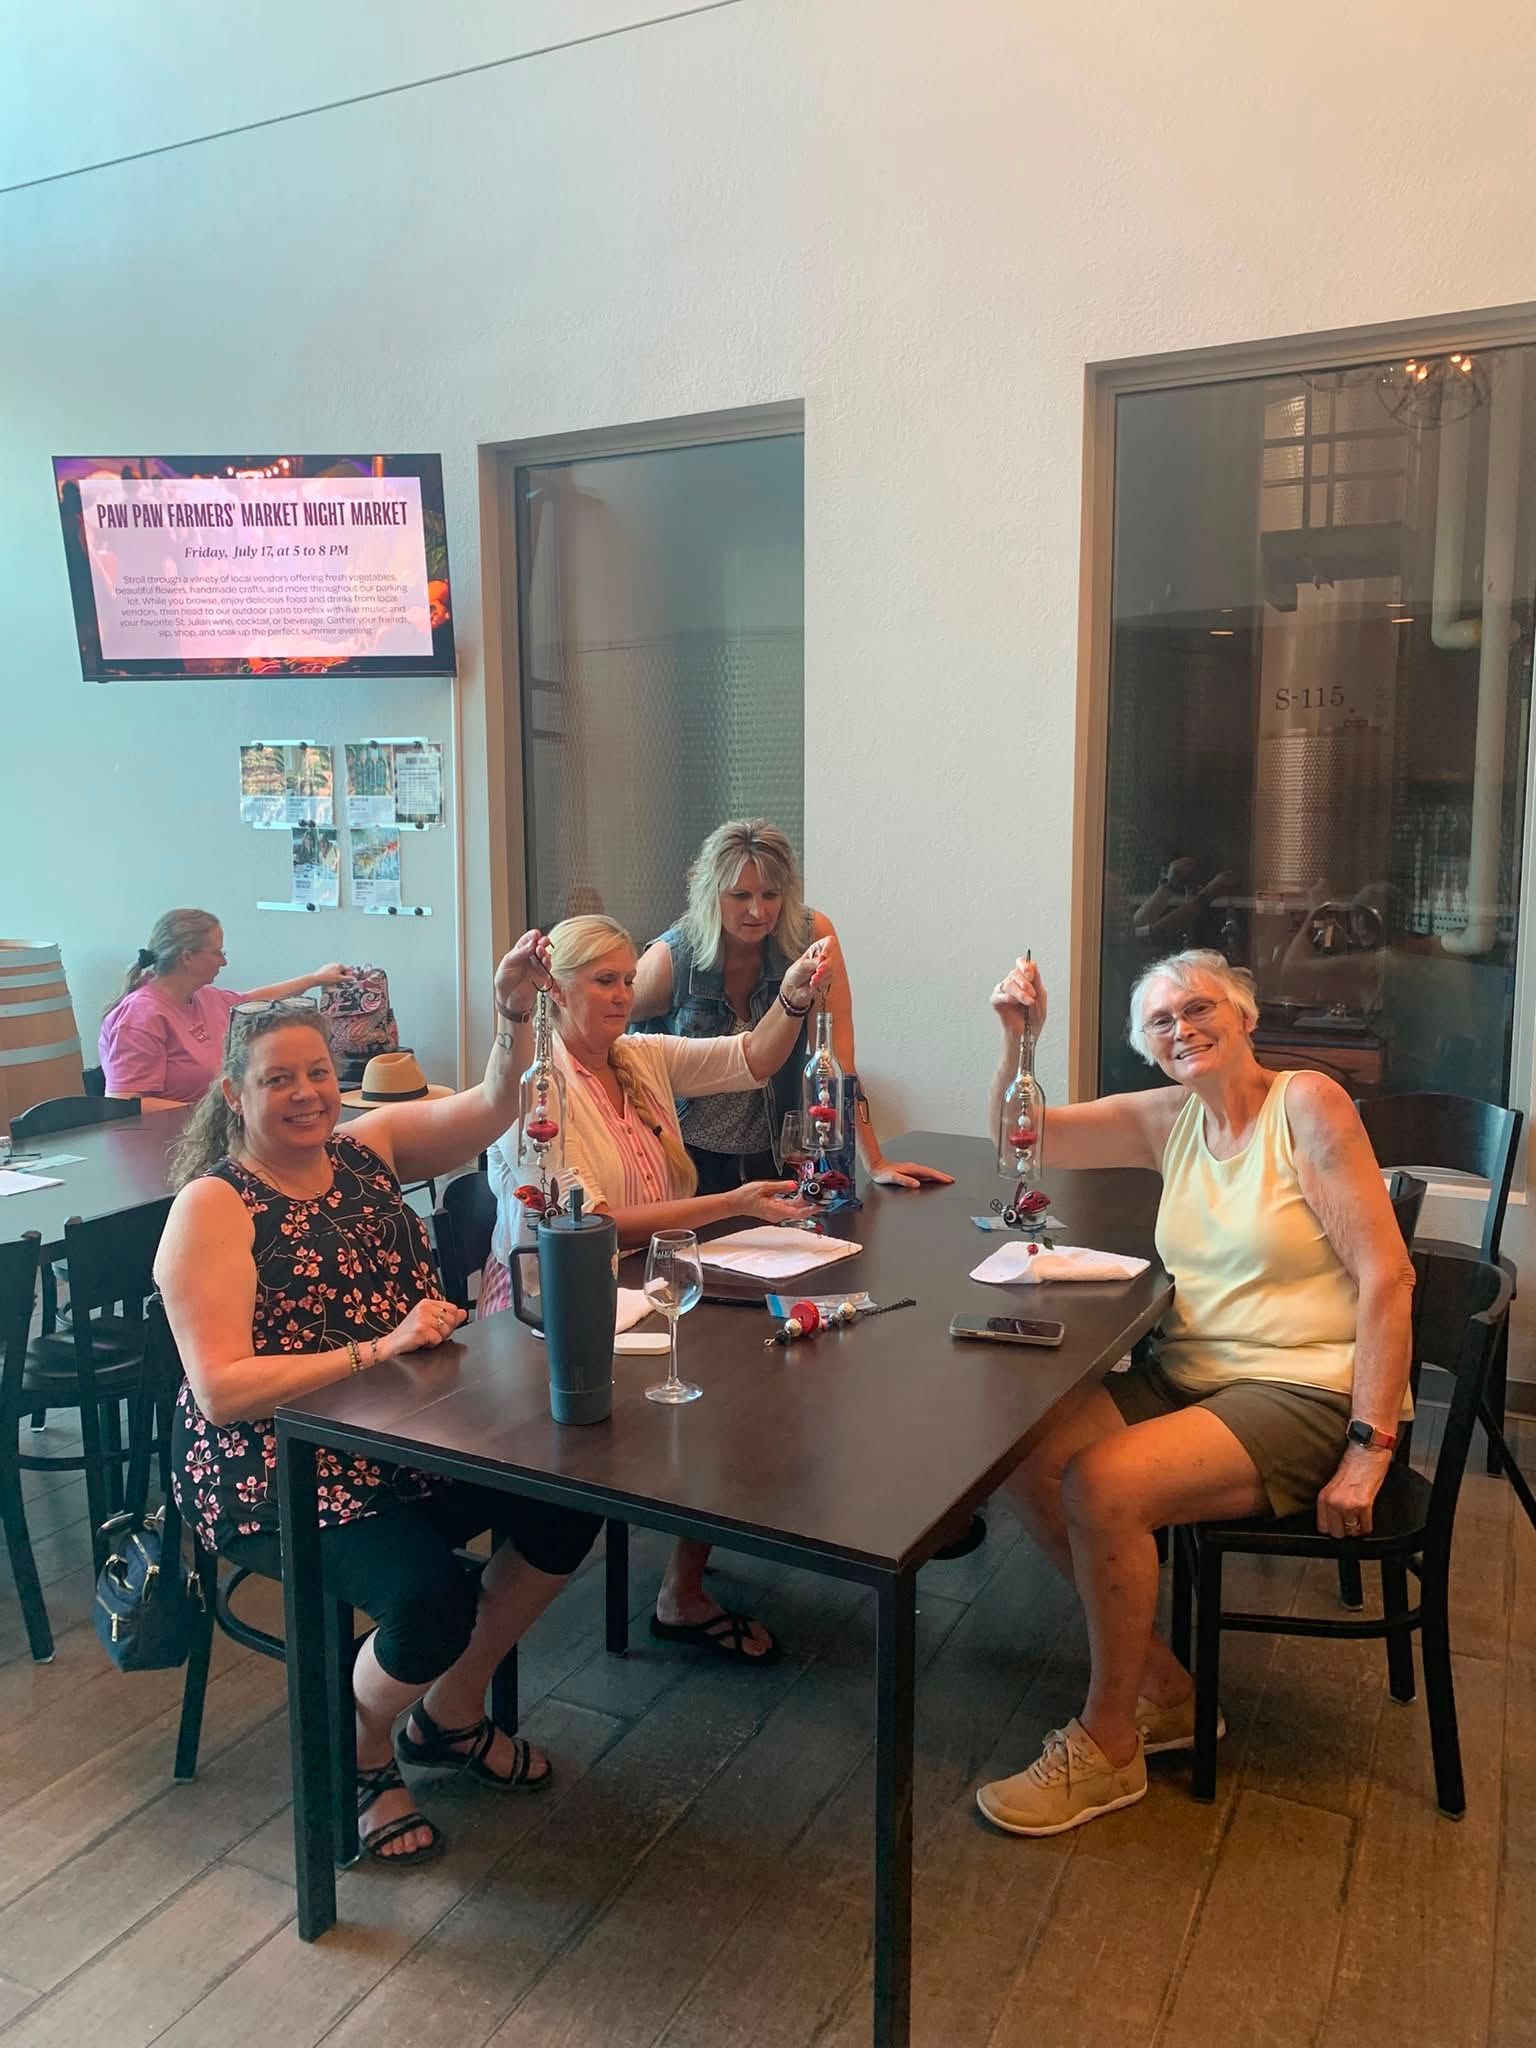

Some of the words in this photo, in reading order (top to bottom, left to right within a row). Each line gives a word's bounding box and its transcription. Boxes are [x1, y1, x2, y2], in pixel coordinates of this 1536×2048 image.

[97, 504, 128, 528] PAW
[132, 503, 163, 528] PAW
[167, 503, 236, 527] FARMERS'
[241, 503, 298, 527] MARKET
[303, 502, 345, 526] NIGHT
[350, 502, 408, 526] MARKET
[185, 547, 228, 560] Friday,
[232, 546, 258, 559] July
[261, 546, 274, 558] 17,
[276, 546, 289, 557] at
[293, 546, 300, 557] 5
[303, 546, 316, 557] to
[318, 545, 326, 556] 8
[329, 545, 349, 556] PM
[147, 575, 180, 584] through
[191, 575, 218, 584] variety
[290, 574, 324, 583] offering
[325, 574, 347, 582] fresh
[115, 586, 153, 594] beautiful
[155, 586, 188, 594] flowers,
[239, 585, 265, 594] crafts,
[267, 585, 283, 593] and
[310, 585, 357, 594] throughout
[376, 585, 408, 594] parking
[142, 597, 166, 605] While
[186, 597, 219, 605] browse,
[221, 596, 244, 606] enjoy
[245, 596, 284, 604] delicious
[309, 595, 325, 603] and
[327, 595, 352, 603] drinks
[181, 607, 203, 615] head
[270, 607, 291, 616] patio
[304, 606, 324, 614] relax
[326, 606, 344, 614] with
[346, 606, 359, 614] live
[120, 620, 138, 628] your
[140, 618, 173, 626] favorite
[327, 616, 356, 624] Gather
[199, 628, 215, 636] and
[217, 628, 235, 636] soak
[268, 628, 300, 637] perfect
[1275, 685, 1344, 710] S-115
